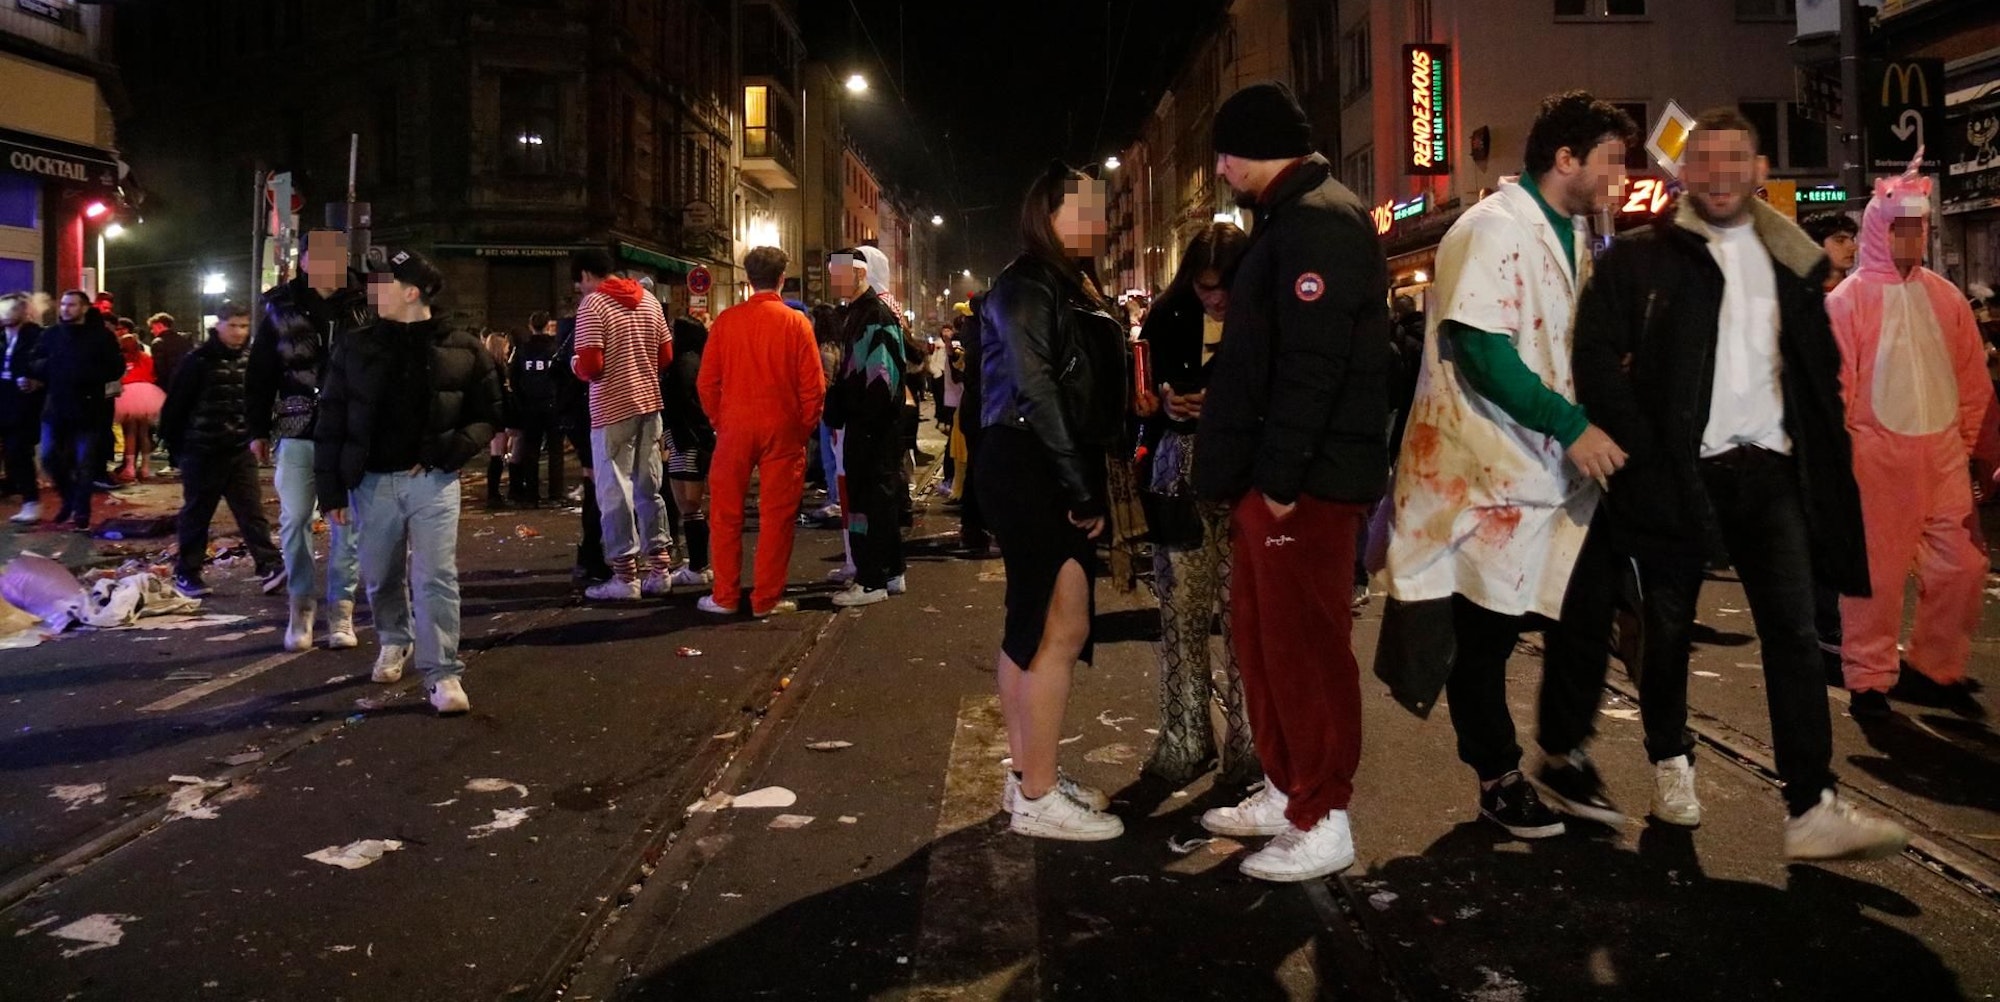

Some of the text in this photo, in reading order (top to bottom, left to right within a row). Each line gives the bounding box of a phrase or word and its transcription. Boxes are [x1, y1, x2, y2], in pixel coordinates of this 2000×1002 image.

[1432, 60, 1442, 111] RESTAURANT
[1412, 50, 1431, 168] RENDEZVOUS
[1433, 117, 1443, 134] BAR
[10, 151, 88, 182] COCKTAIL
